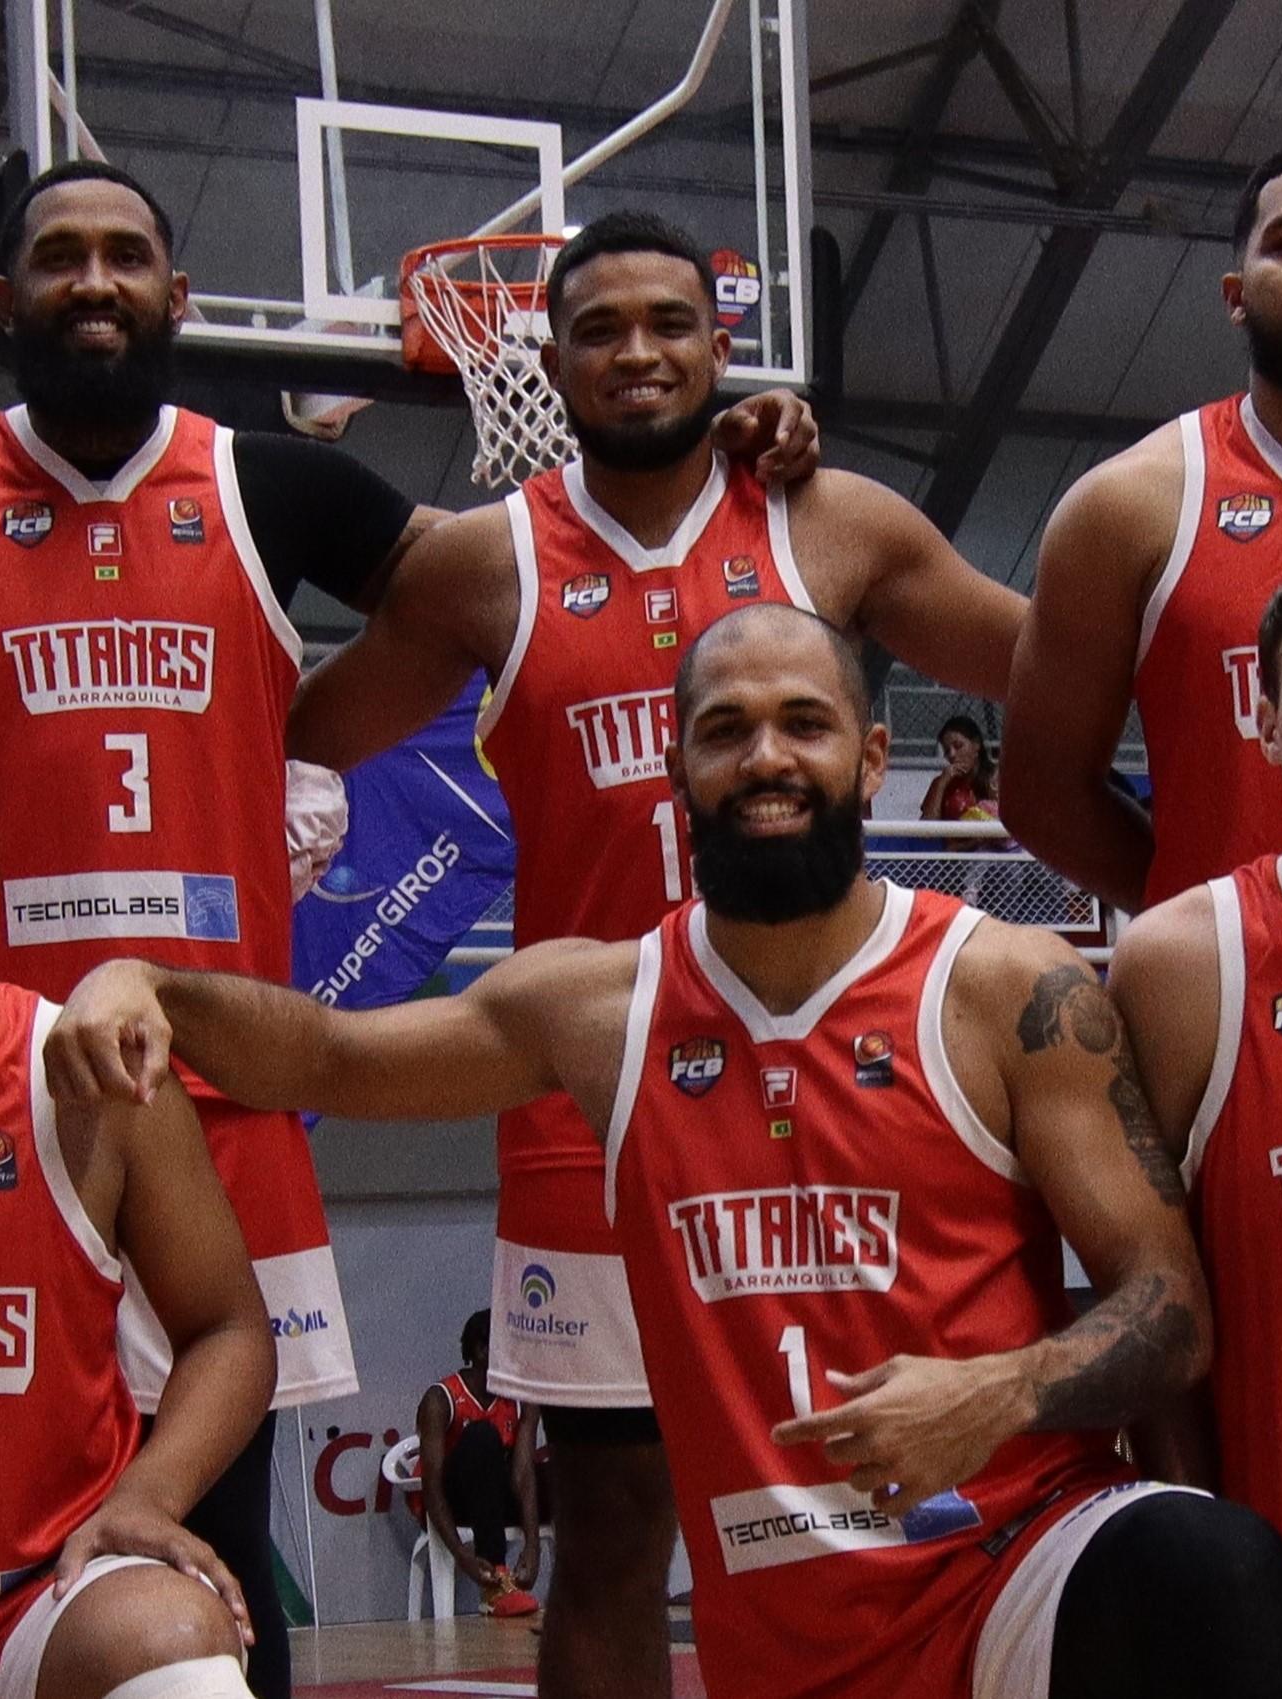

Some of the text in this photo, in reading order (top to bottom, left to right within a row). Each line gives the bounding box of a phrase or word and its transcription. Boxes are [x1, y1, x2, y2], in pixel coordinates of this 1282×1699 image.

[716, 276, 760, 304] CB
[5, 516, 53, 537] FCB
[1218, 511, 1272, 529] FCB
[563, 584, 610, 606] FCB
[9, 626, 208, 692] TITANES
[58, 690, 182, 707] BARRANQUILLA
[104, 733, 152, 833] 3
[12, 897, 180, 923] TECNOGLASS
[310, 831, 461, 1007] Super GIROS
[671, 1059, 724, 1082] FCB
[674, 1192, 890, 1279] TITANES
[724, 1270, 863, 1292] BARRANQUILLA
[722, 1509, 891, 1547] TECNOGLASS
